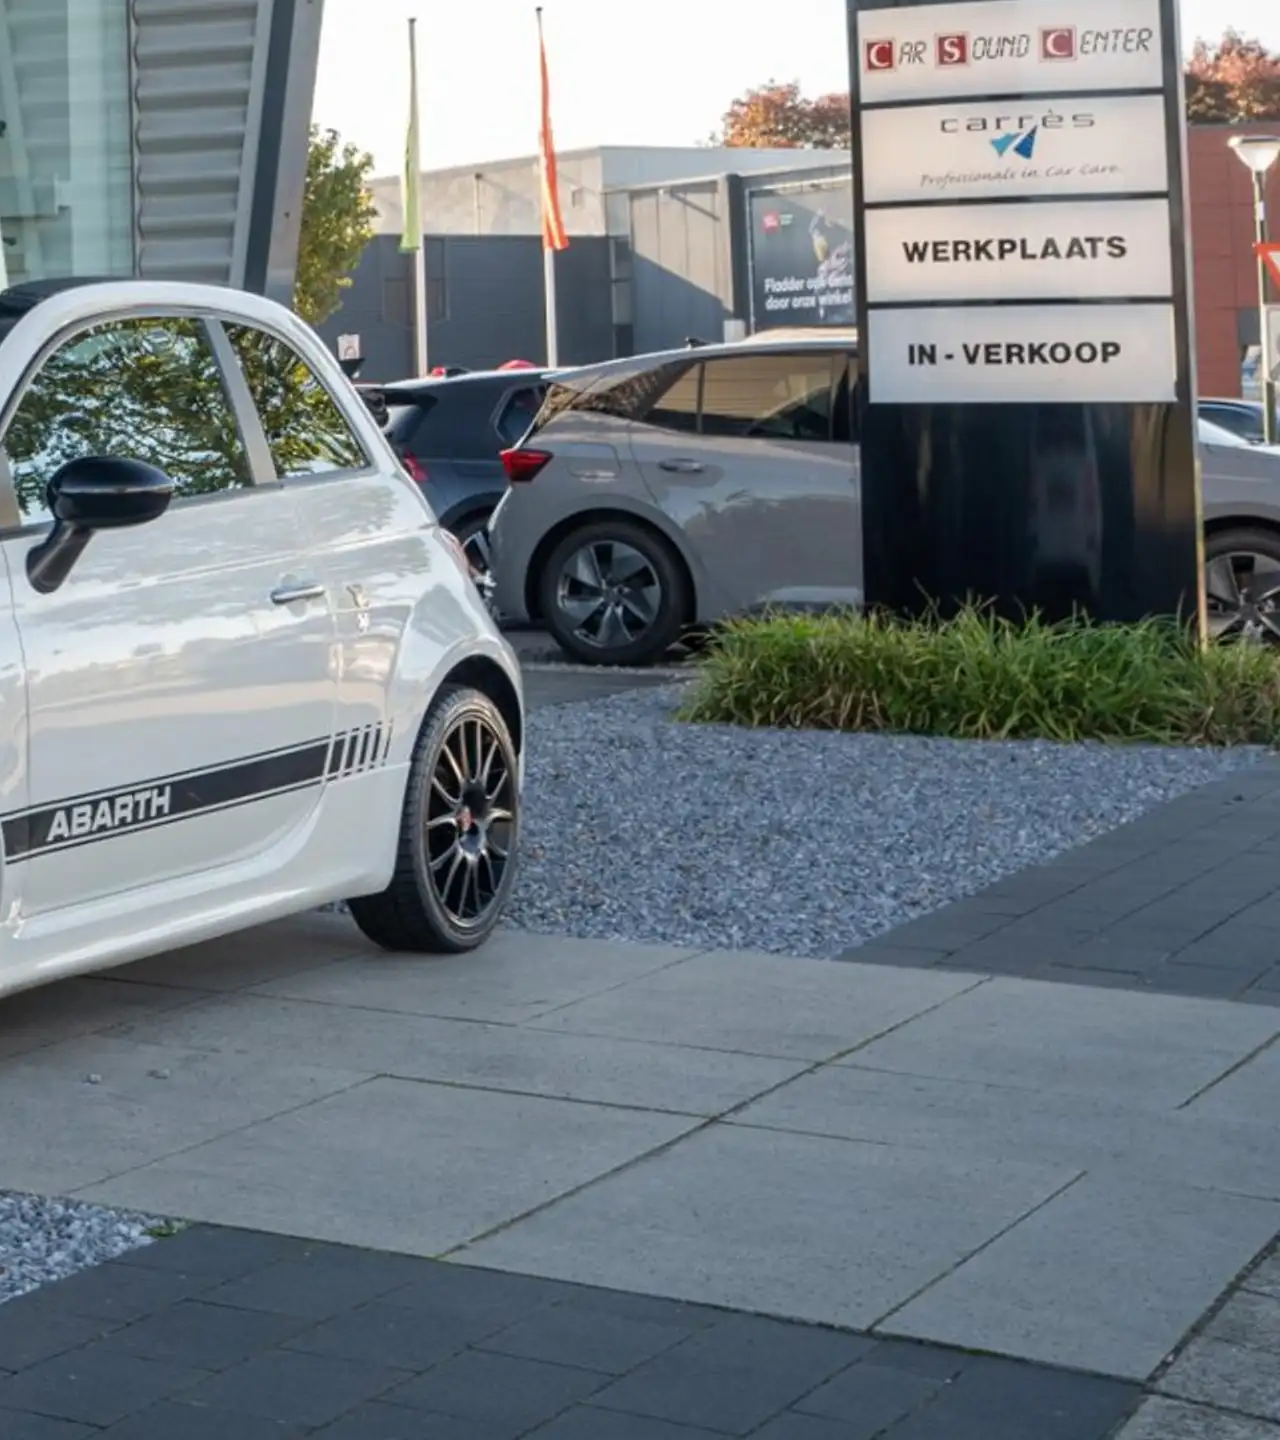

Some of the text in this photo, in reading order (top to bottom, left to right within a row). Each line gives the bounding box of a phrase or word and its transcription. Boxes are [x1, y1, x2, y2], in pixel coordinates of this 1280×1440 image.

[866, 26, 1153, 70] CAR SOUND CENTER
[940, 109, 1096, 134] carrès
[902, 235, 1128, 262] WERKPLAATS
[962, 341, 1121, 365] VERKOOP
[46, 785, 172, 842] ABARTH
